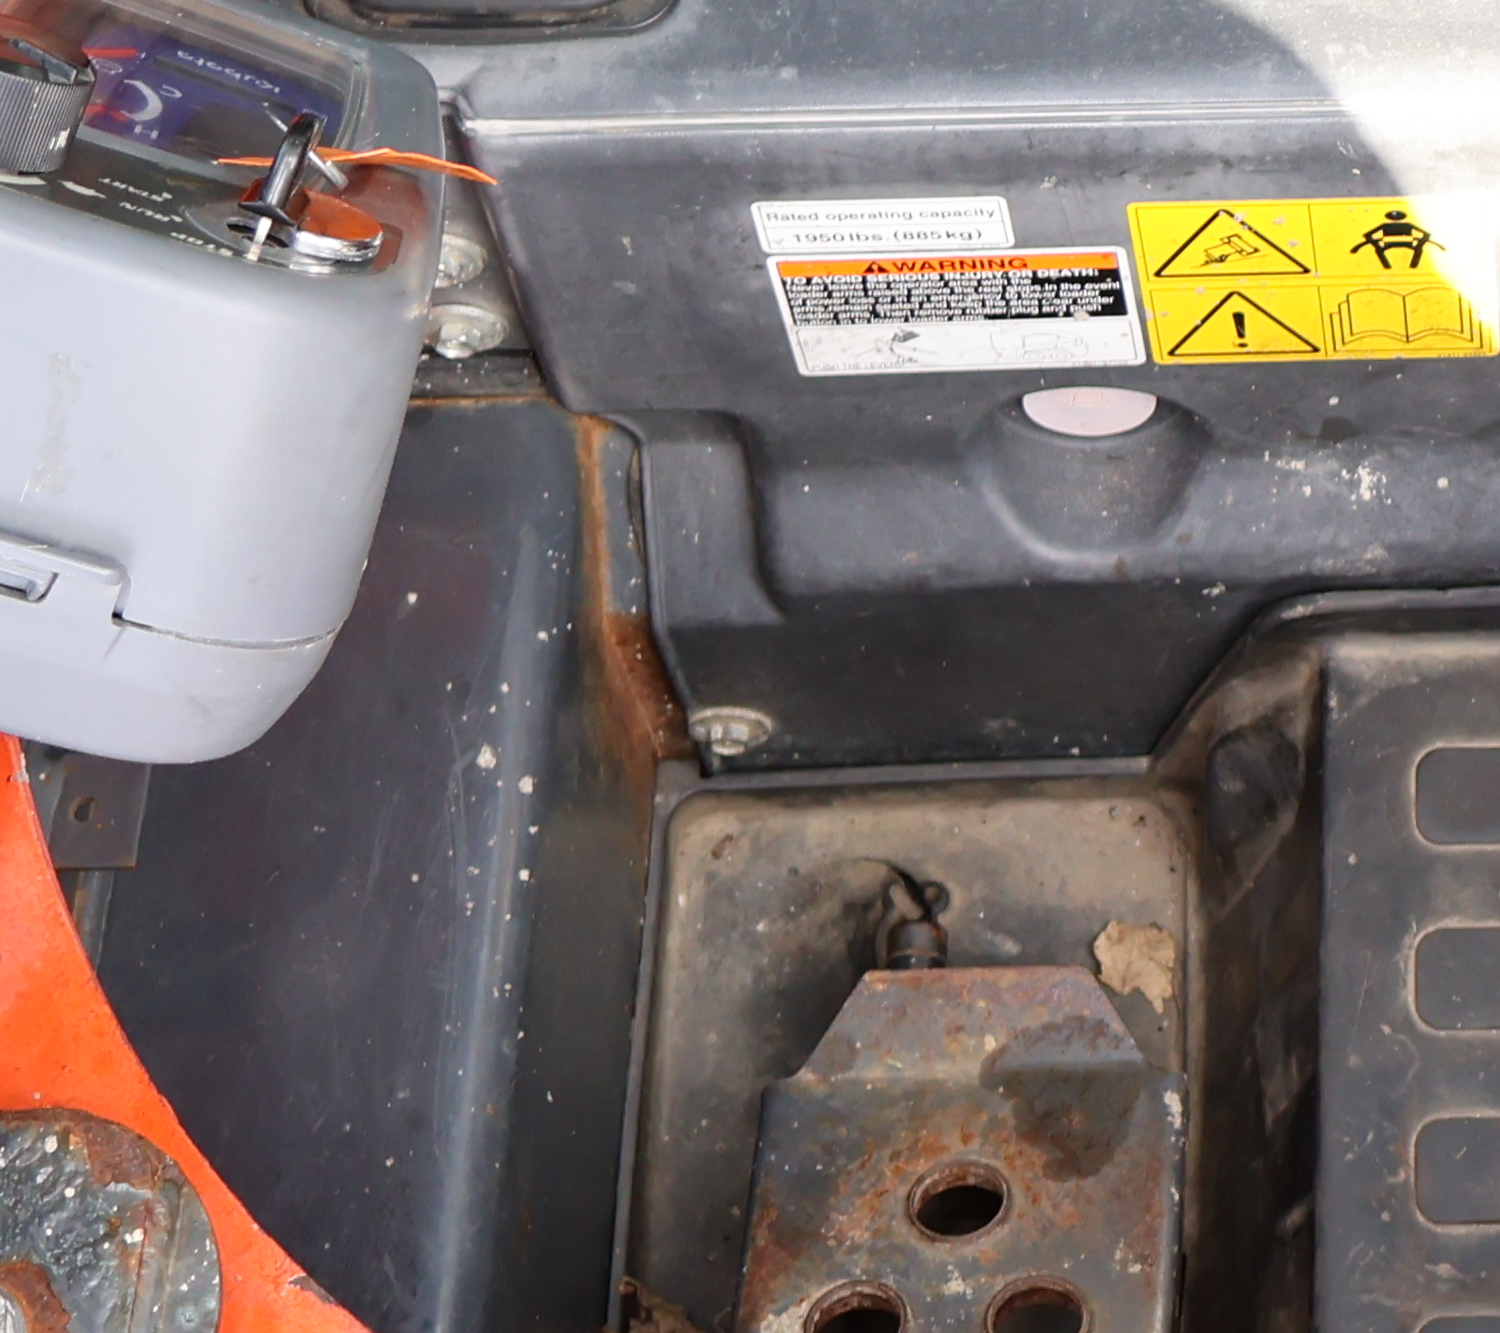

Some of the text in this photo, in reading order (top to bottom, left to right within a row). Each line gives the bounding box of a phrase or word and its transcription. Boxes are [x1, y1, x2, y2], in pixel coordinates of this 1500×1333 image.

[764, 207, 996, 222] Rated operating capacity
[892, 256, 1028, 272] WARNING
[783, 275, 807, 285] TO
[809, 274, 864, 284] AVOID
[865, 272, 941, 282] SERIOUS
[942, 270, 1005, 280] INJURY
[1007, 269, 1034, 278] OR
